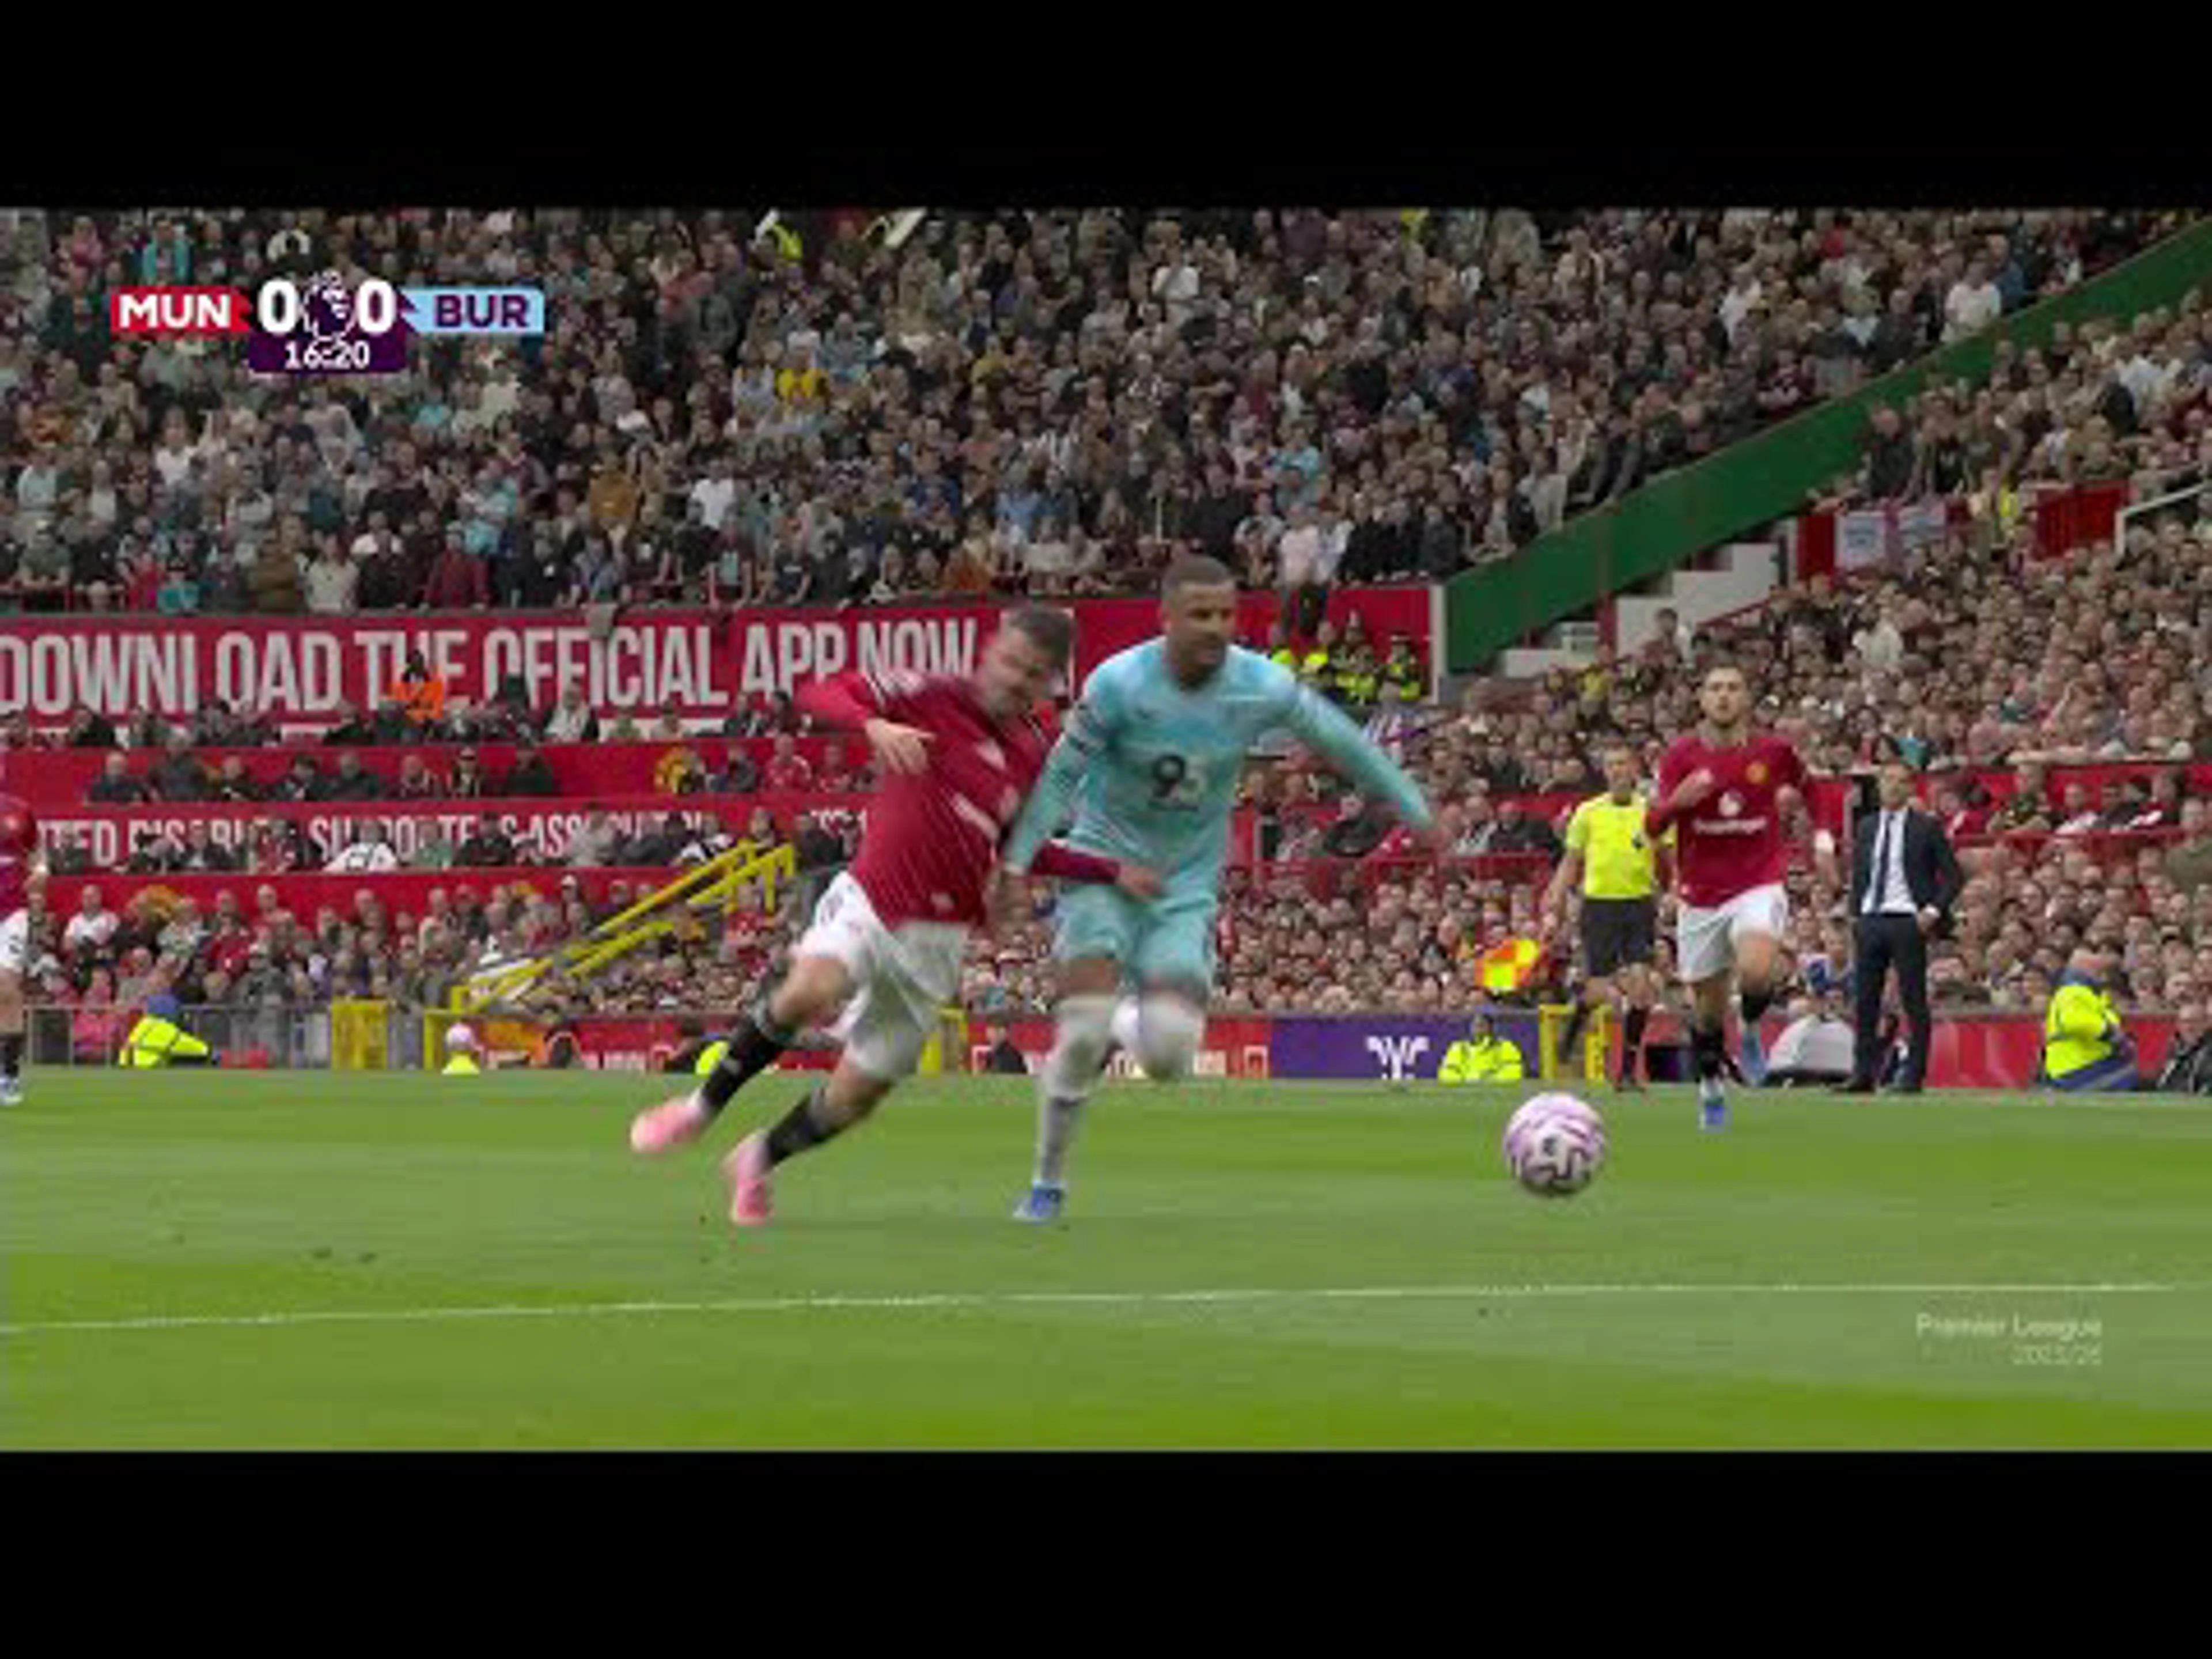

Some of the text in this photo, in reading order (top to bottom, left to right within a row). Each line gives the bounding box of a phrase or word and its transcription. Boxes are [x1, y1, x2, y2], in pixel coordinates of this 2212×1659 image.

[483, 626, 729, 706] OFFICIAL
[741, 622, 844, 702] APP
[857, 619, 978, 677] NOW
